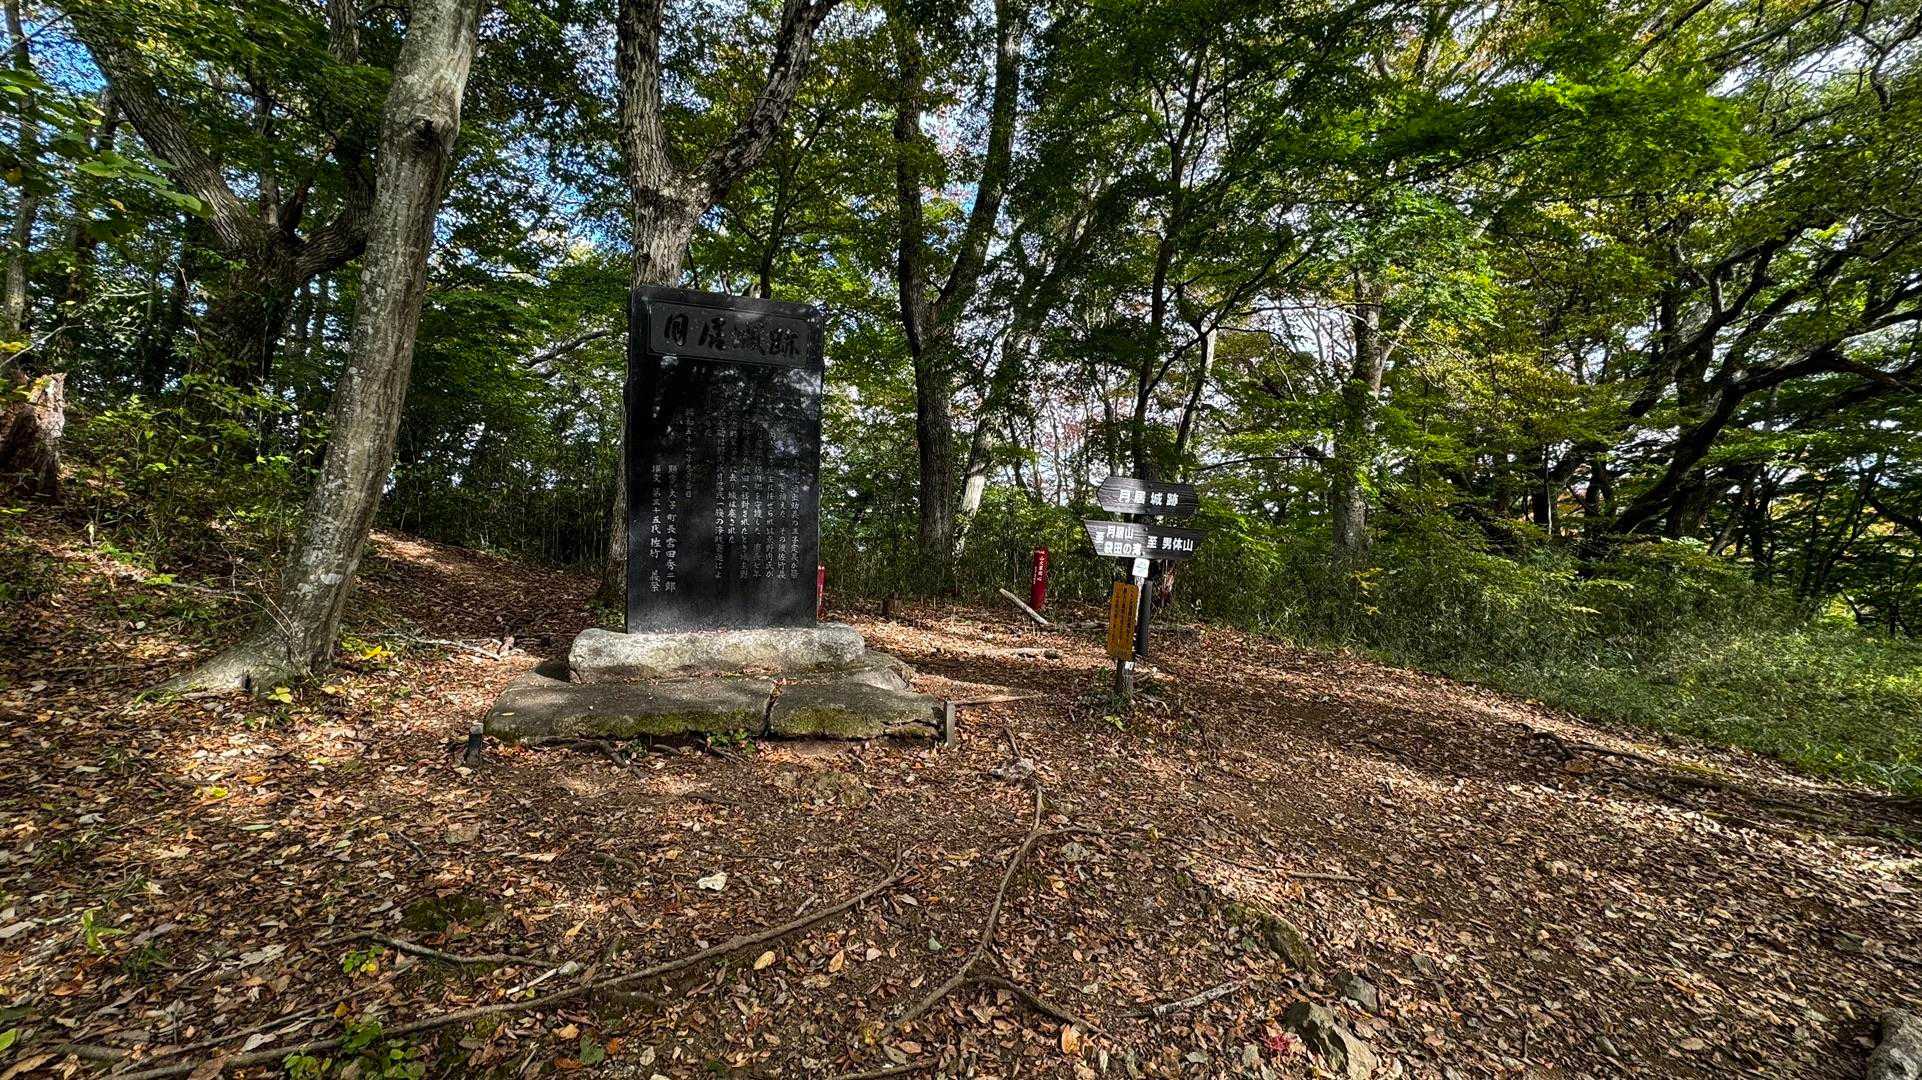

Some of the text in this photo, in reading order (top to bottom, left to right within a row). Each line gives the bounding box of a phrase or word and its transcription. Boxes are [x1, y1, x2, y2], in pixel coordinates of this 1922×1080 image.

[1147, 535, 1194, 552] 至 男体山
